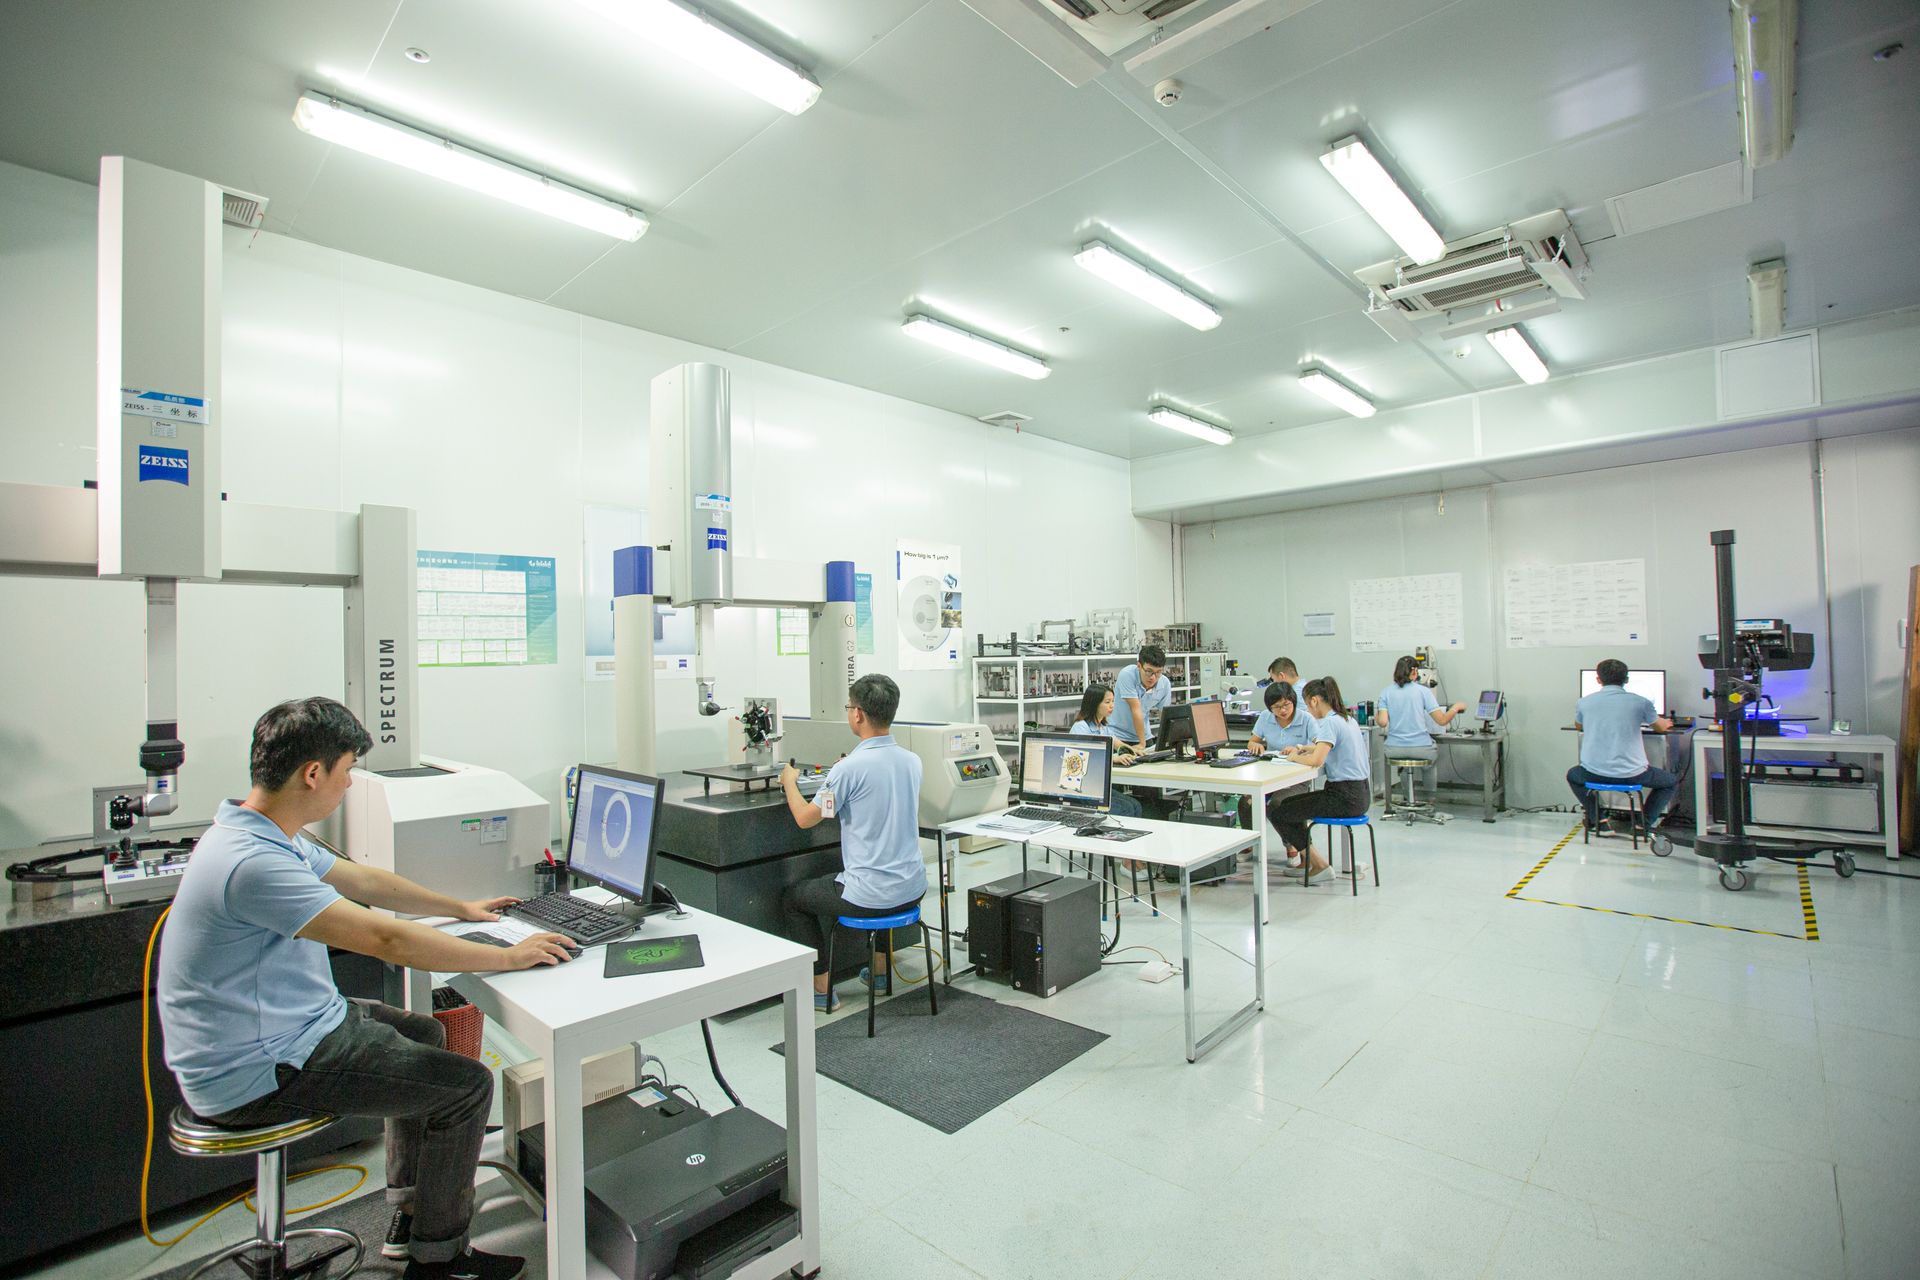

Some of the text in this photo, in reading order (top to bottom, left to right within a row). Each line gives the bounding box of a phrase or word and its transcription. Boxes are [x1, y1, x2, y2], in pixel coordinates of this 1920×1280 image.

[124, 402, 145, 411] ZEISS
[140, 455, 188, 469] ZEISS
[708, 533, 728, 541] ZEISS
[917, 552, 926, 560] big
[379, 639, 395, 744] SPECTRUM
